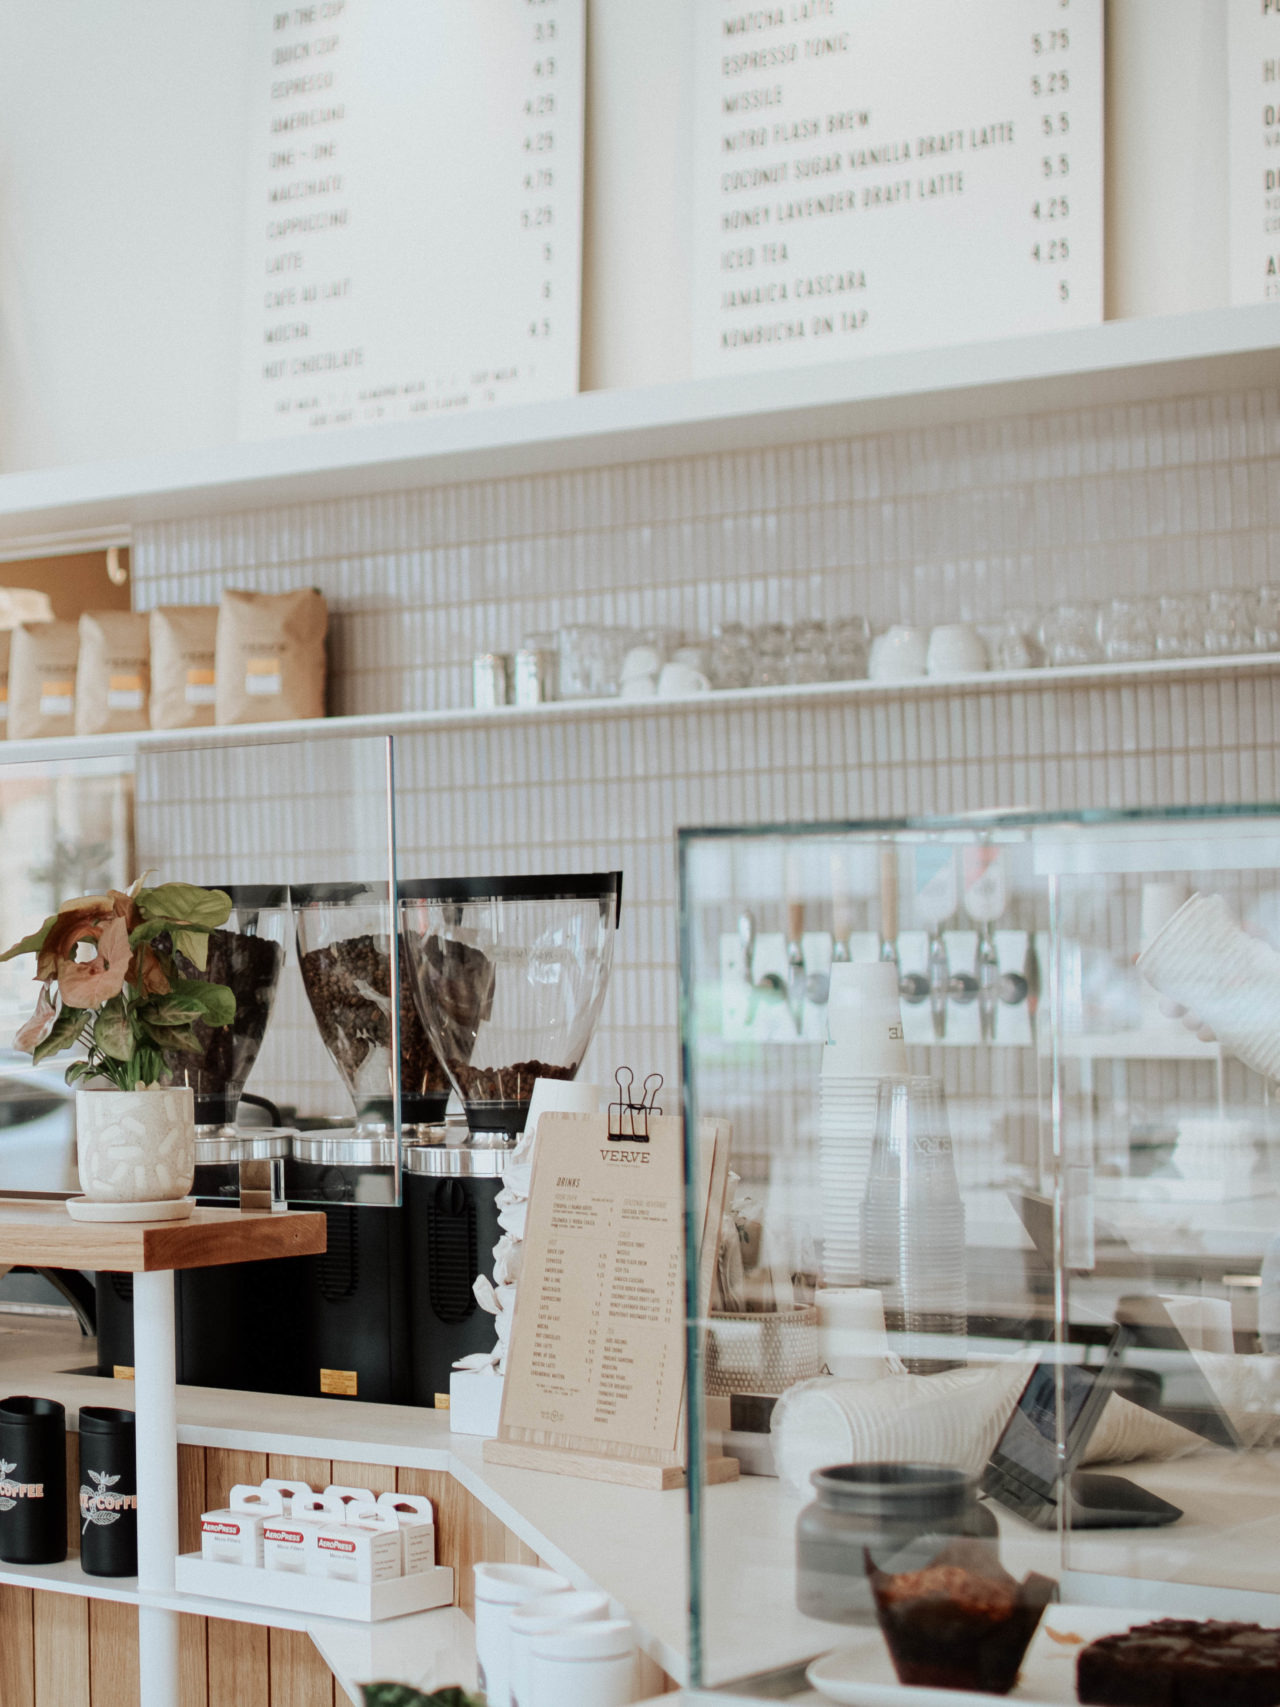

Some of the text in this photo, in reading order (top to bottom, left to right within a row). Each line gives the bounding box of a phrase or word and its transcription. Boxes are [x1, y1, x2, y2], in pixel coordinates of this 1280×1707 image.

[722, 0, 834, 37] MATCHA LATTE
[722, 32, 850, 77] ESPRESSO TONIC
[1031, 28, 1070, 57] 5.75
[271, 71, 333, 100] ESPRESSO
[1031, 69, 1070, 98] 5.25
[722, 85, 783, 114] MISSILE
[270, 104, 345, 135] AMERICANO
[722, 110, 870, 152] NITRO FLASH BREW
[721, 120, 1016, 194] COCONUT SUGAR VANILLA DRAFT LATTE
[721, 170, 964, 232] HONEY LAVENDER DRAFT LATTE
[1030, 196, 1070, 221] 4.25
[265, 207, 348, 240] CAPPUCCINO
[721, 242, 789, 270] ICED TEA
[1030, 237, 1070, 264] 4.25
[721, 270, 867, 310] JAMAICA CASCARA
[1058, 280, 1070, 304] 5
[720, 310, 869, 350] KOMBUCHA ON TAP
[600, 1149, 651, 1163] VERVE
[556, 1176, 581, 1188] DRINKS
